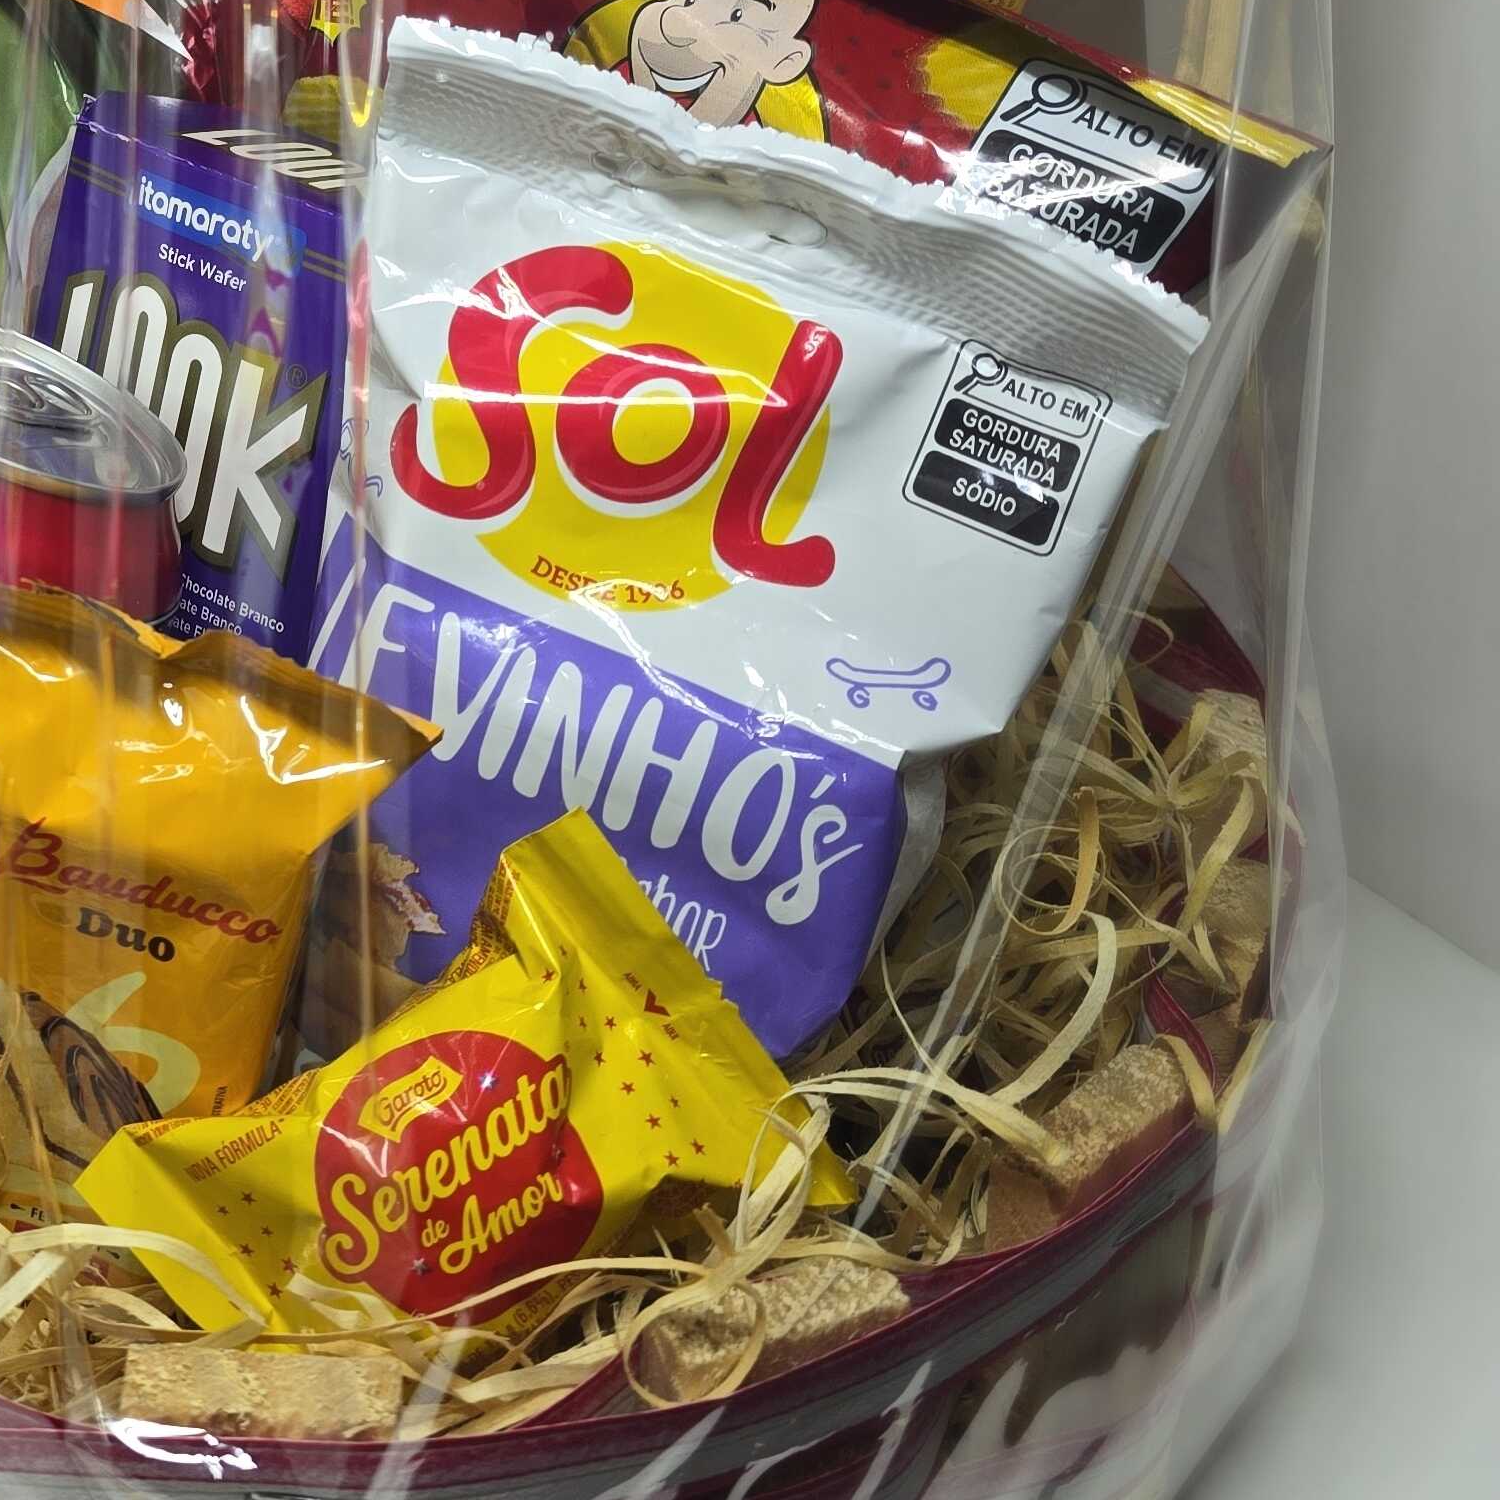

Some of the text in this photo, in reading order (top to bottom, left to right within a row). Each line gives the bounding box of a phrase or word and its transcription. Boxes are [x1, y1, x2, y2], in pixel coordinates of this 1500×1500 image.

[1072, 105, 1210, 169] ALTO EM
[1008, 143, 1155, 223] GORDURA
[137, 176, 275, 262] itamaraty
[158, 243, 247, 293] Stick Wafer
[390, 244, 844, 588] Sol
[1001, 378, 1090, 423] ALTO EM
[949, 428, 1055, 487] SATURADA
[963, 408, 1061, 463] GORDURA
[952, 476, 1017, 516] SÓDIO
[201, 605, 243, 637] Branco
[238, 601, 285, 633] Branco
[76, 906, 176, 962] Duo
[379, 1069, 448, 1128] Garoto
[214, 1120, 283, 1171] FÓRMULA
[326, 1063, 570, 1275] Serenata
[421, 1171, 564, 1275] de Amor
